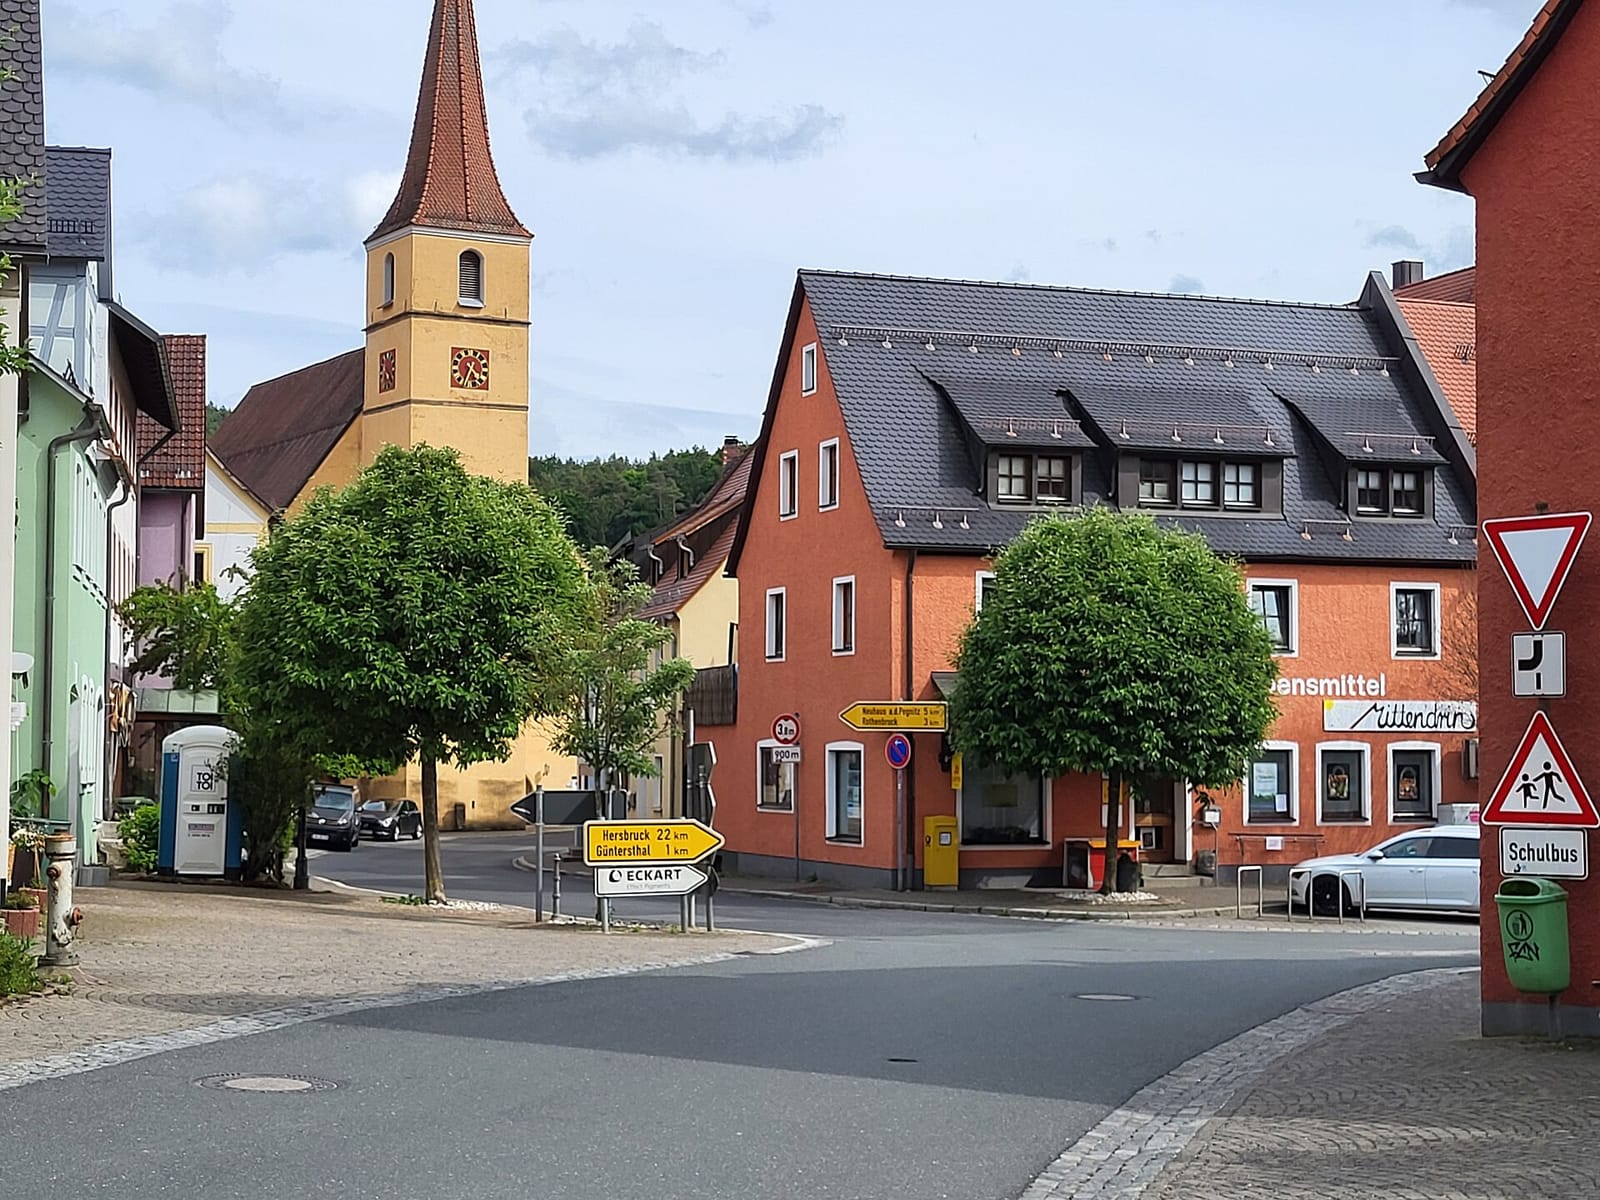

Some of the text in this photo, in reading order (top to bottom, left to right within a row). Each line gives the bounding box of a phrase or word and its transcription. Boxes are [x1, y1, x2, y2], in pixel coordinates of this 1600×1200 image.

[923, 707, 928, 715] 5
[774, 750, 790, 759] 900
[603, 829, 688, 841] Hersbruck 22 km
[596, 845, 651, 857] Güntersthal
[666, 844, 670, 855] 1
[1509, 842, 1578, 863] Schulbus
[627, 869, 682, 881] ECKART
